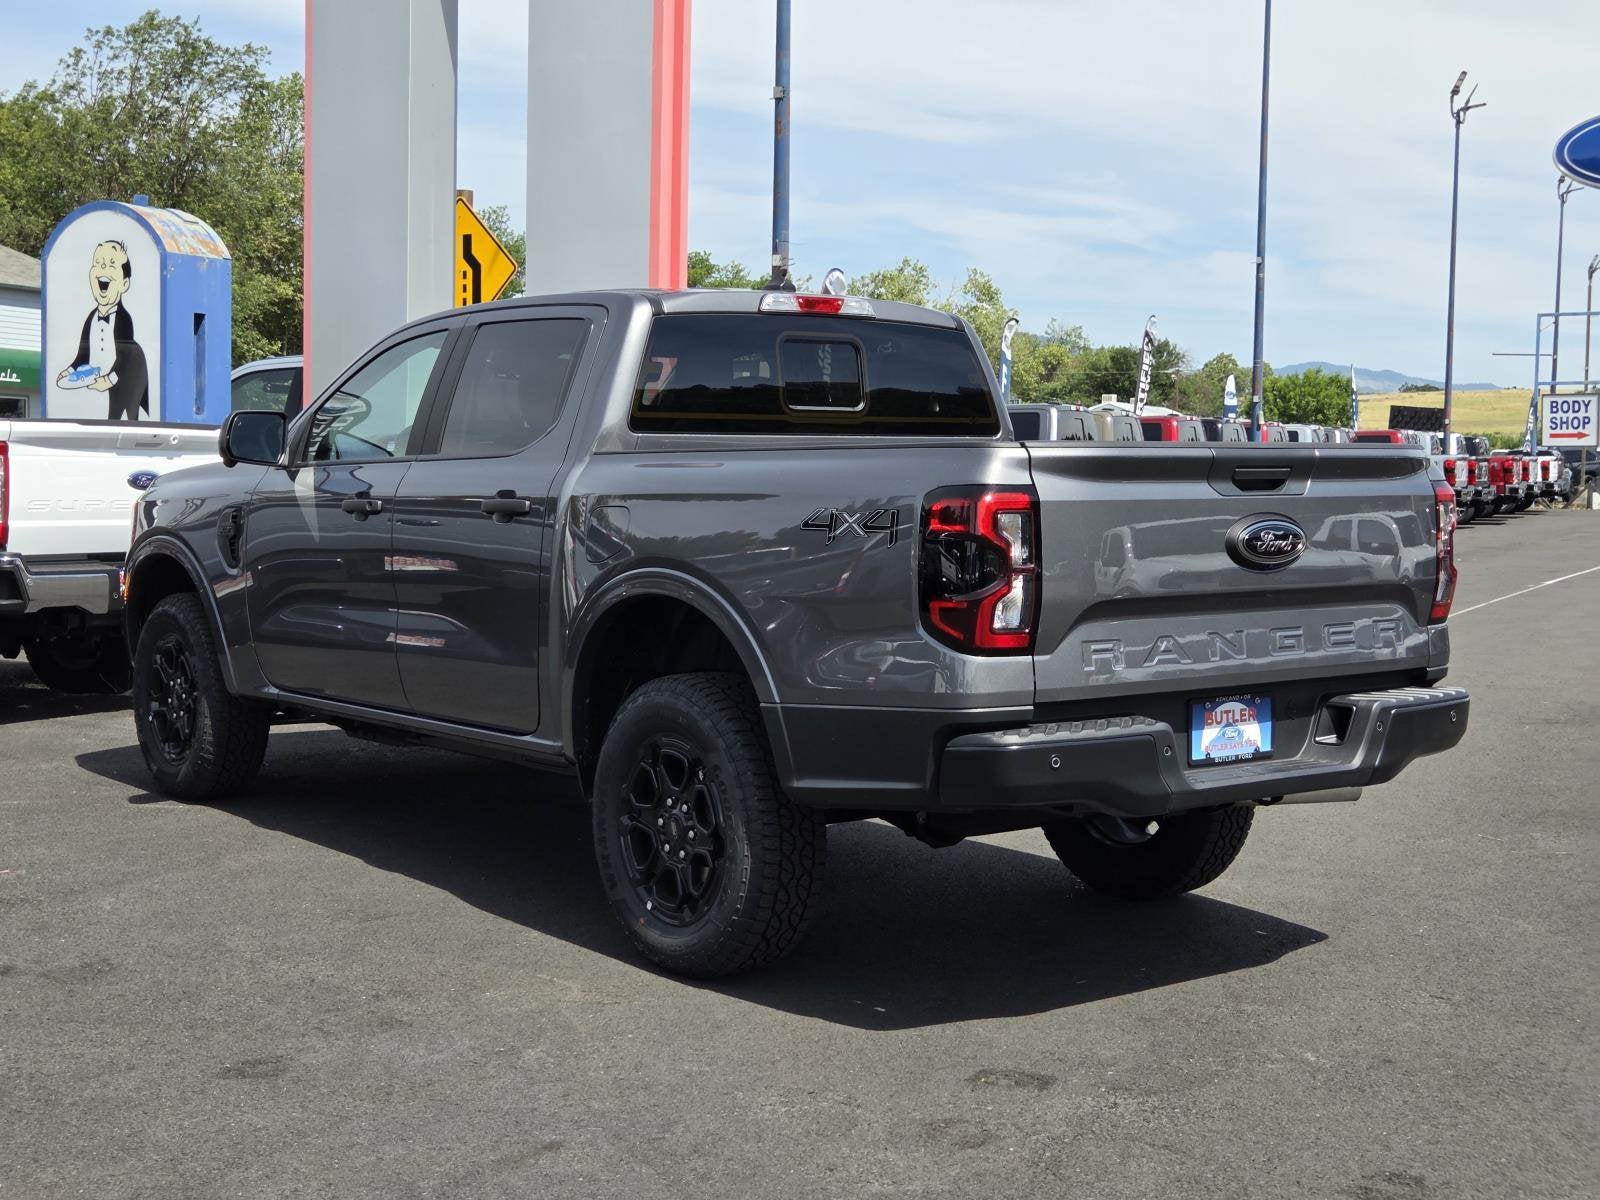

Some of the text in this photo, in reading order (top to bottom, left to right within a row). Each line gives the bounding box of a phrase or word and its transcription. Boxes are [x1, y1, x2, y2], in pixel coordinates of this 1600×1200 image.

[1549, 400, 1592, 414] BODY
[1549, 416, 1591, 430] SHOP
[26, 499, 131, 512] SUPE
[1254, 529, 1296, 553] Ford
[1081, 619, 1404, 671] RANGER
[1205, 707, 1256, 726] BUTLER
[1215, 754, 1236, 762] BUTLER
